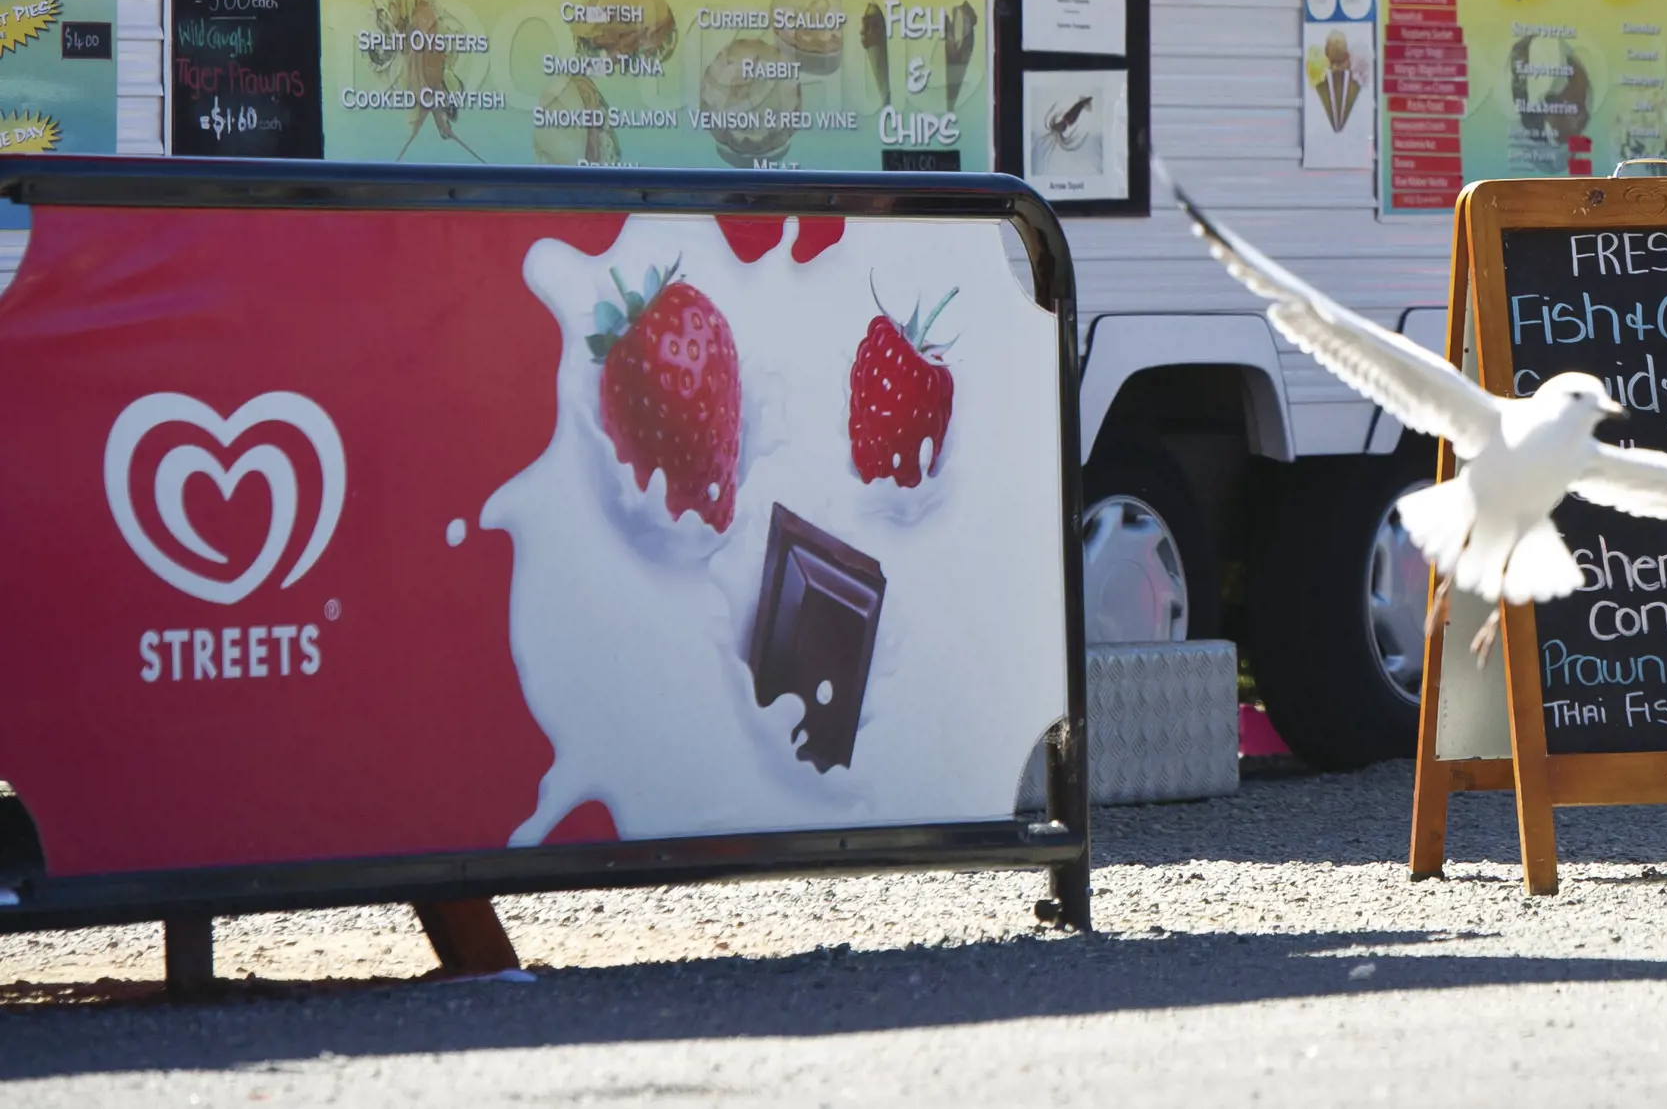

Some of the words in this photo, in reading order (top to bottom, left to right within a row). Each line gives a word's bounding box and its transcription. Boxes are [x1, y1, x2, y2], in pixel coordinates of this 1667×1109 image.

[13, 0, 51, 22] PIES
[560, 2, 644, 23] CRFISH
[699, 8, 769, 29] CURRIED
[774, 9, 847, 30] SCALLOP
[886, 0, 946, 40] FISH
[358, 30, 406, 52] SPLIT
[410, 30, 489, 53] OYSTERS
[617, 54, 664, 76] TUNA
[743, 58, 801, 79] RABBIT
[908, 57, 930, 93] &
[176, 57, 223, 100] Tiger
[228, 60, 305, 97] Prawns
[342, 88, 417, 110] COOKED
[419, 88, 506, 110] CRAYFISH
[1515, 99, 1579, 115] Blackberries
[533, 107, 604, 128] SMOKED
[608, 107, 678, 128] SALMON
[689, 108, 761, 129] VENISON
[764, 110, 776, 128] &
[781, 110, 812, 129] RED
[817, 111, 857, 129] WINE
[878, 109, 960, 146] CHIPS
[14, 124, 47, 146] DAY
[1512, 292, 1622, 345] Fish
[139, 623, 322, 683] STREETS
[1542, 639, 1667, 688] Prawn
